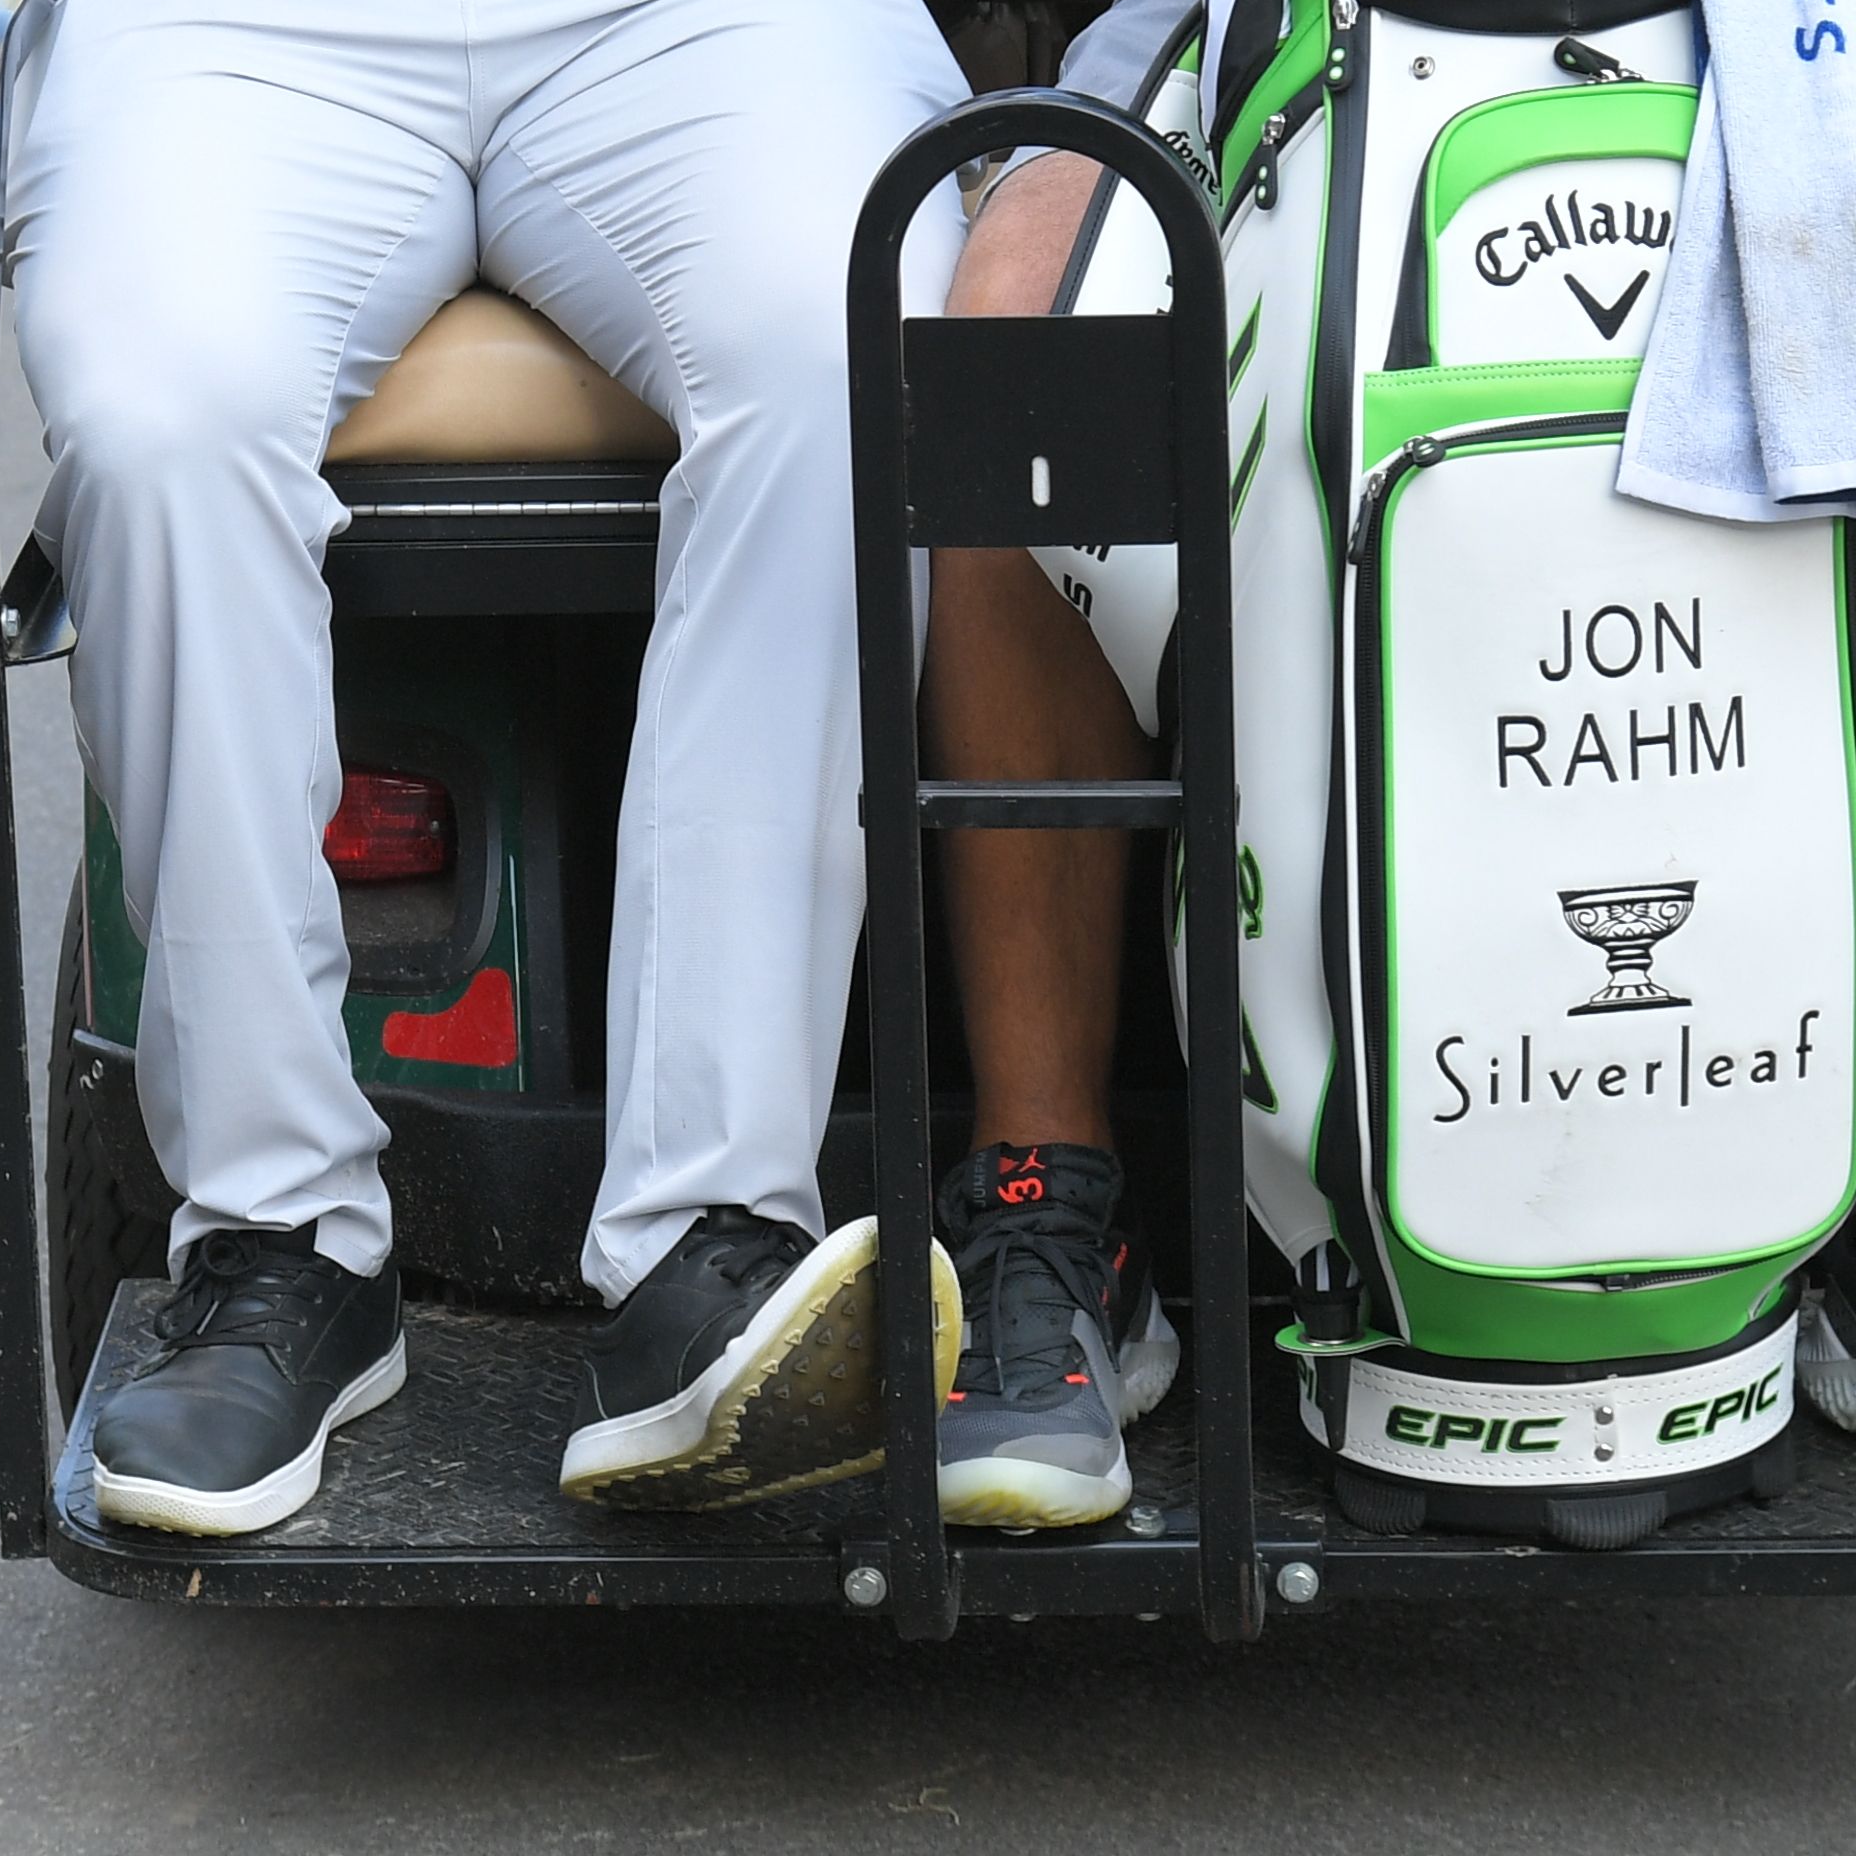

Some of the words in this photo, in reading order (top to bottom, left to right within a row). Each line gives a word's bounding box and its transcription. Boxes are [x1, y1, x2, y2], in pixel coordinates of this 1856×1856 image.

[1475, 188, 1675, 287] Callaw
[1539, 596, 1703, 682] JON
[1496, 695, 1746, 789] RAHM
[1432, 1009, 1821, 1124] Silverleaf
[1385, 1404, 1568, 1454] EPIC
[1656, 1363, 1784, 1446] EPIC
